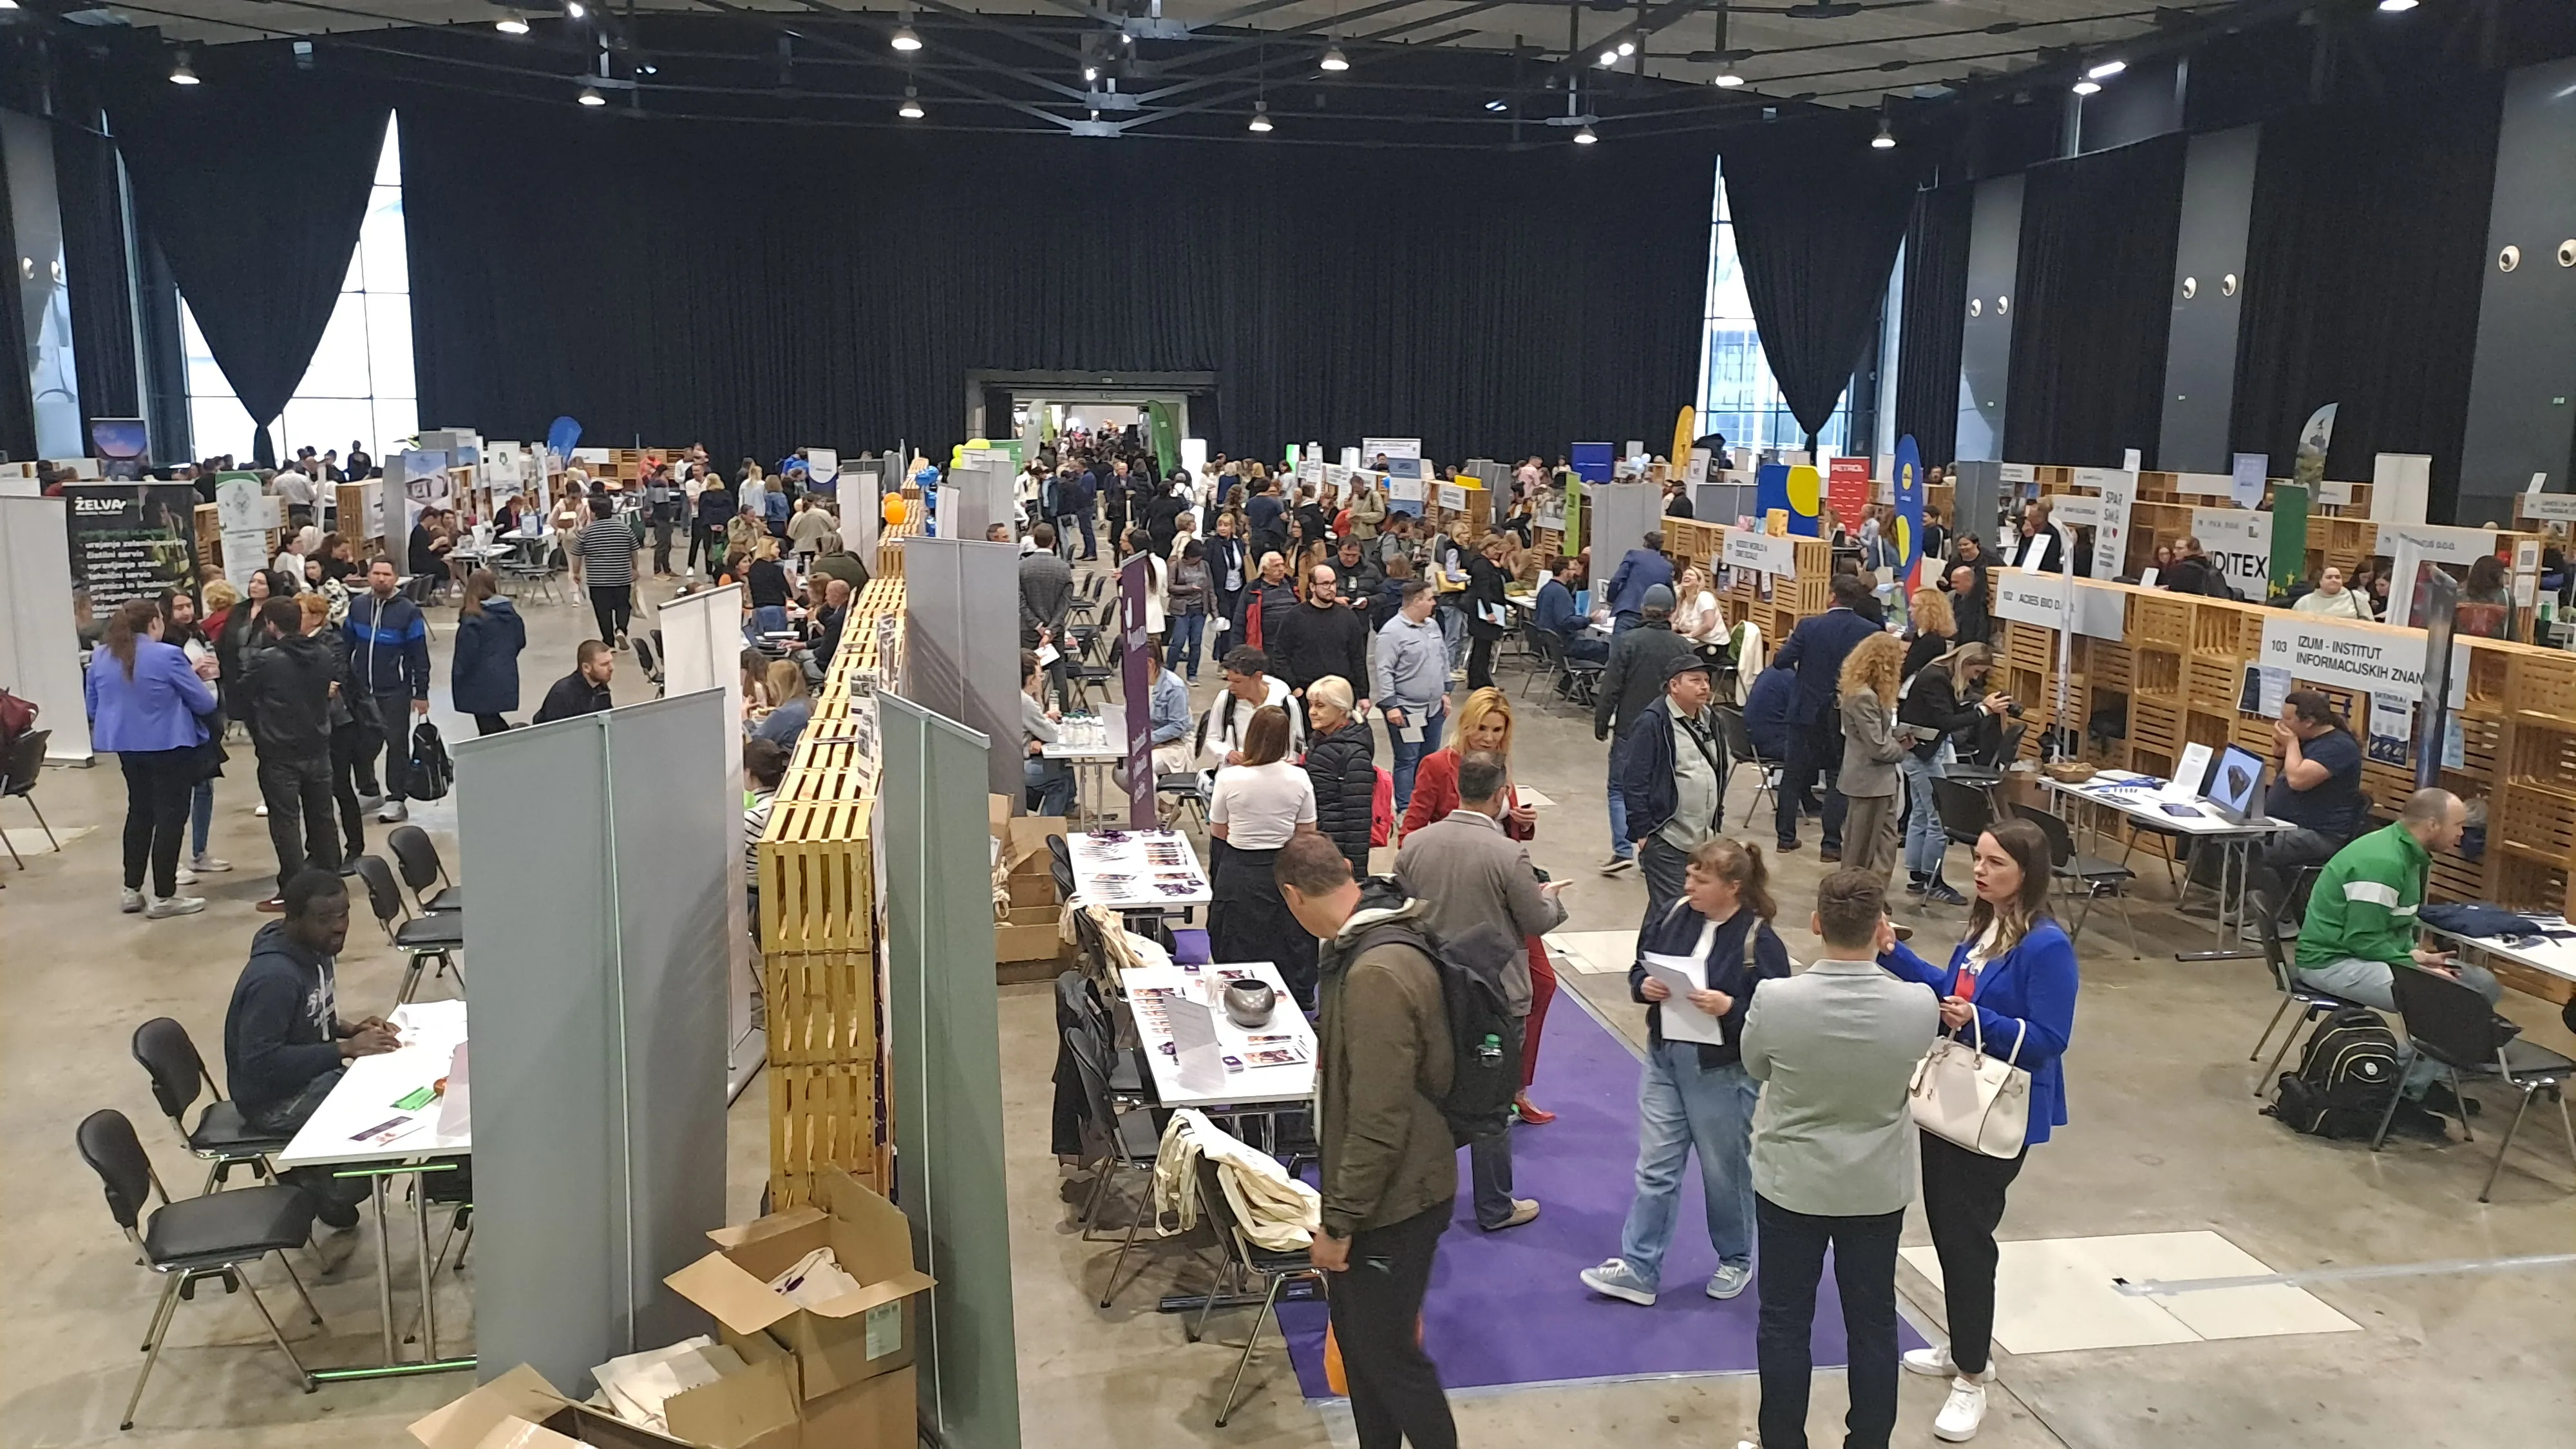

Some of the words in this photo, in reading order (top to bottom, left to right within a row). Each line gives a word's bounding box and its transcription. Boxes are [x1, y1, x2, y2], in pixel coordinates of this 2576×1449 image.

[1831, 464, 1865, 472] PETROL
[75, 497, 127, 511] ŽELVA
[2105, 491, 2123, 507] SPAR
[2210, 551, 2268, 579] DITEX
[2271, 639, 2287, 653] 103
[2297, 635, 2324, 651] IZUM
[2332, 641, 2383, 660] INSTITUT
[2296, 652, 2388, 679] INFORMACIJSKIH
